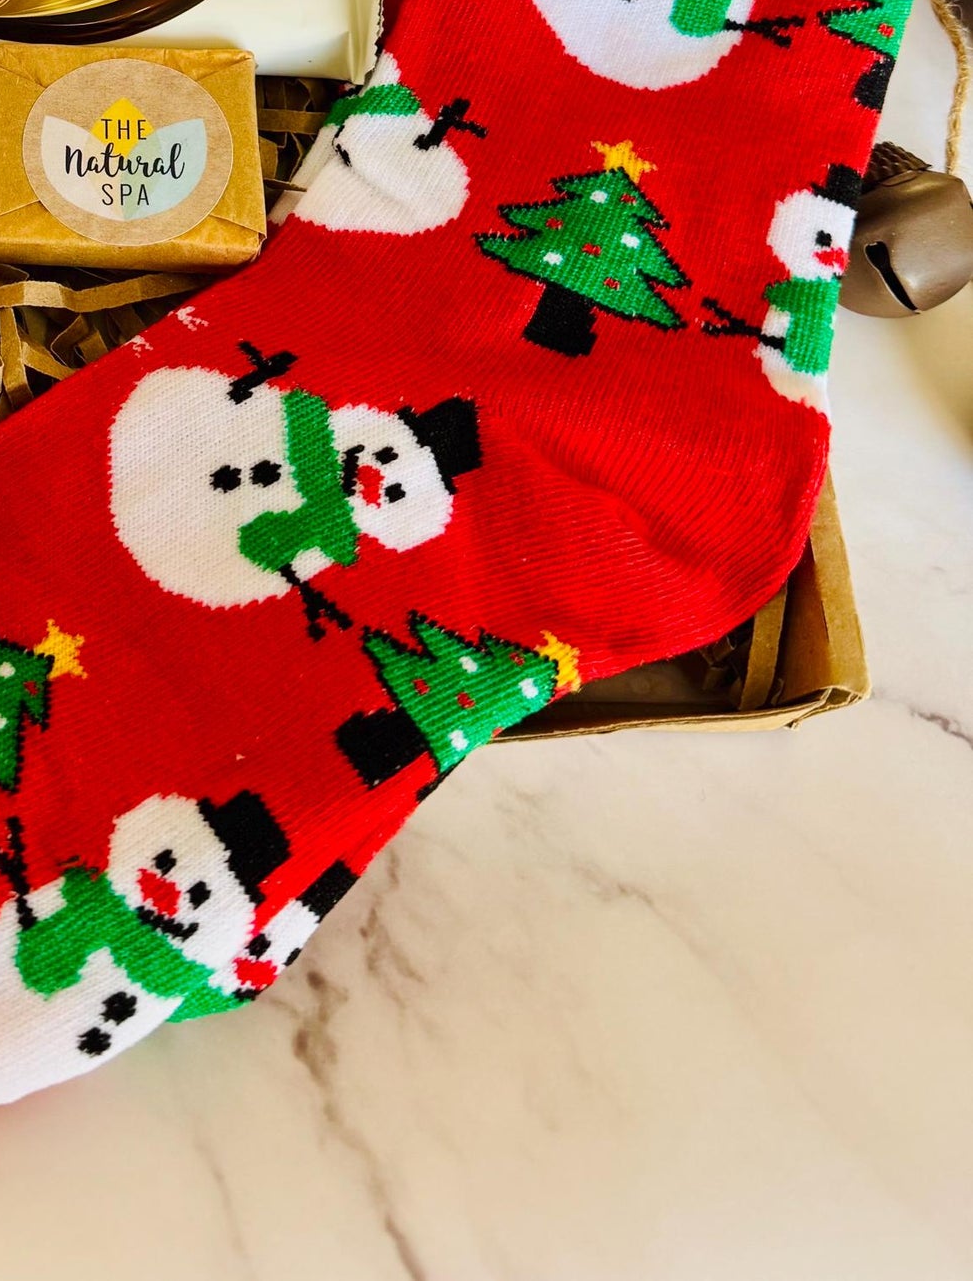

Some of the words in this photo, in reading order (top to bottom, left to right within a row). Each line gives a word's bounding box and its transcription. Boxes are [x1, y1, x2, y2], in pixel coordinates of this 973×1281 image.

[101, 118, 148, 140] THE
[65, 142, 185, 180] Natural
[101, 183, 150, 206] SPA
